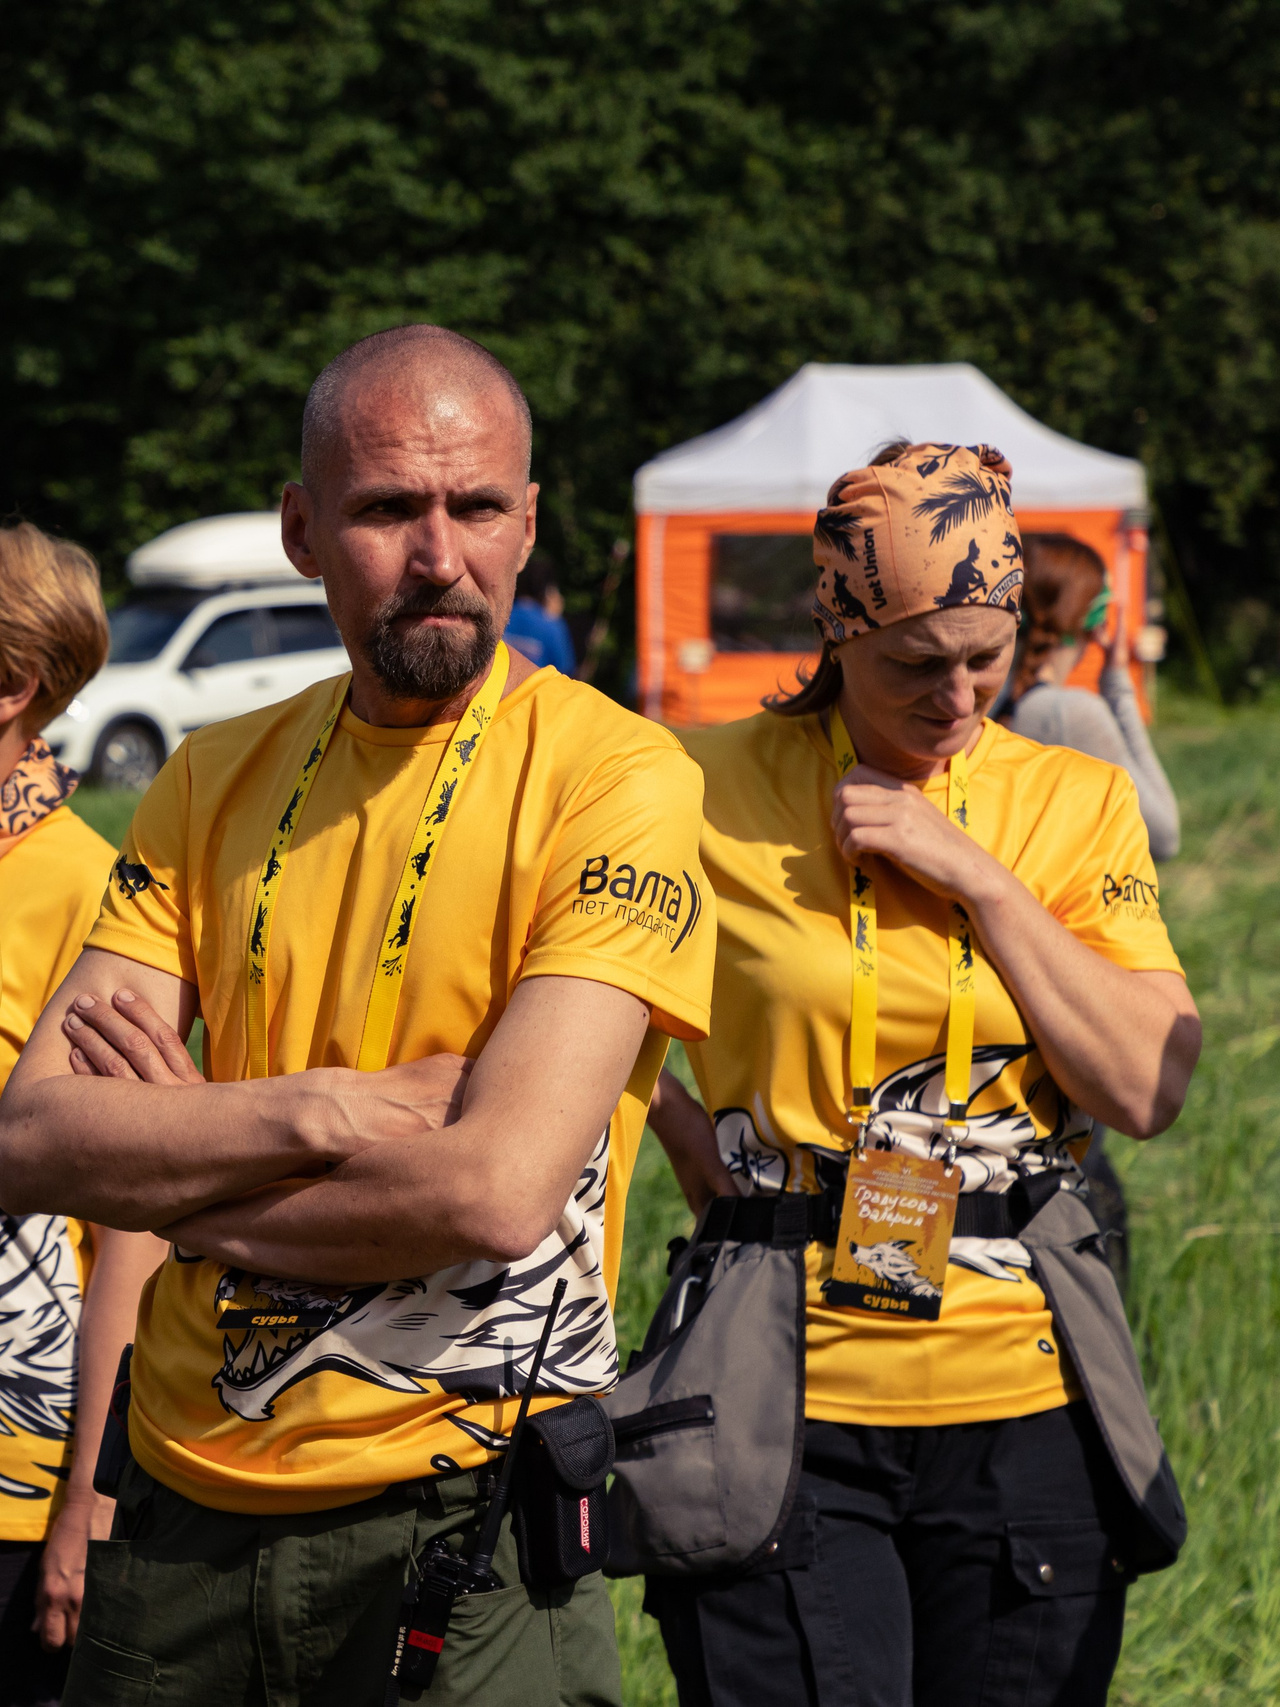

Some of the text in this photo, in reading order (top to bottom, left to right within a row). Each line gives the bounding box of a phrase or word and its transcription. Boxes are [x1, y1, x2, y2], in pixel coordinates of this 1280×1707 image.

[862, 528, 888, 611] Vet Union
[578, 854, 682, 924] Валта
[572, 899, 676, 944] пет продактс
[580, 1497, 590, 1546] СОРОКИН
